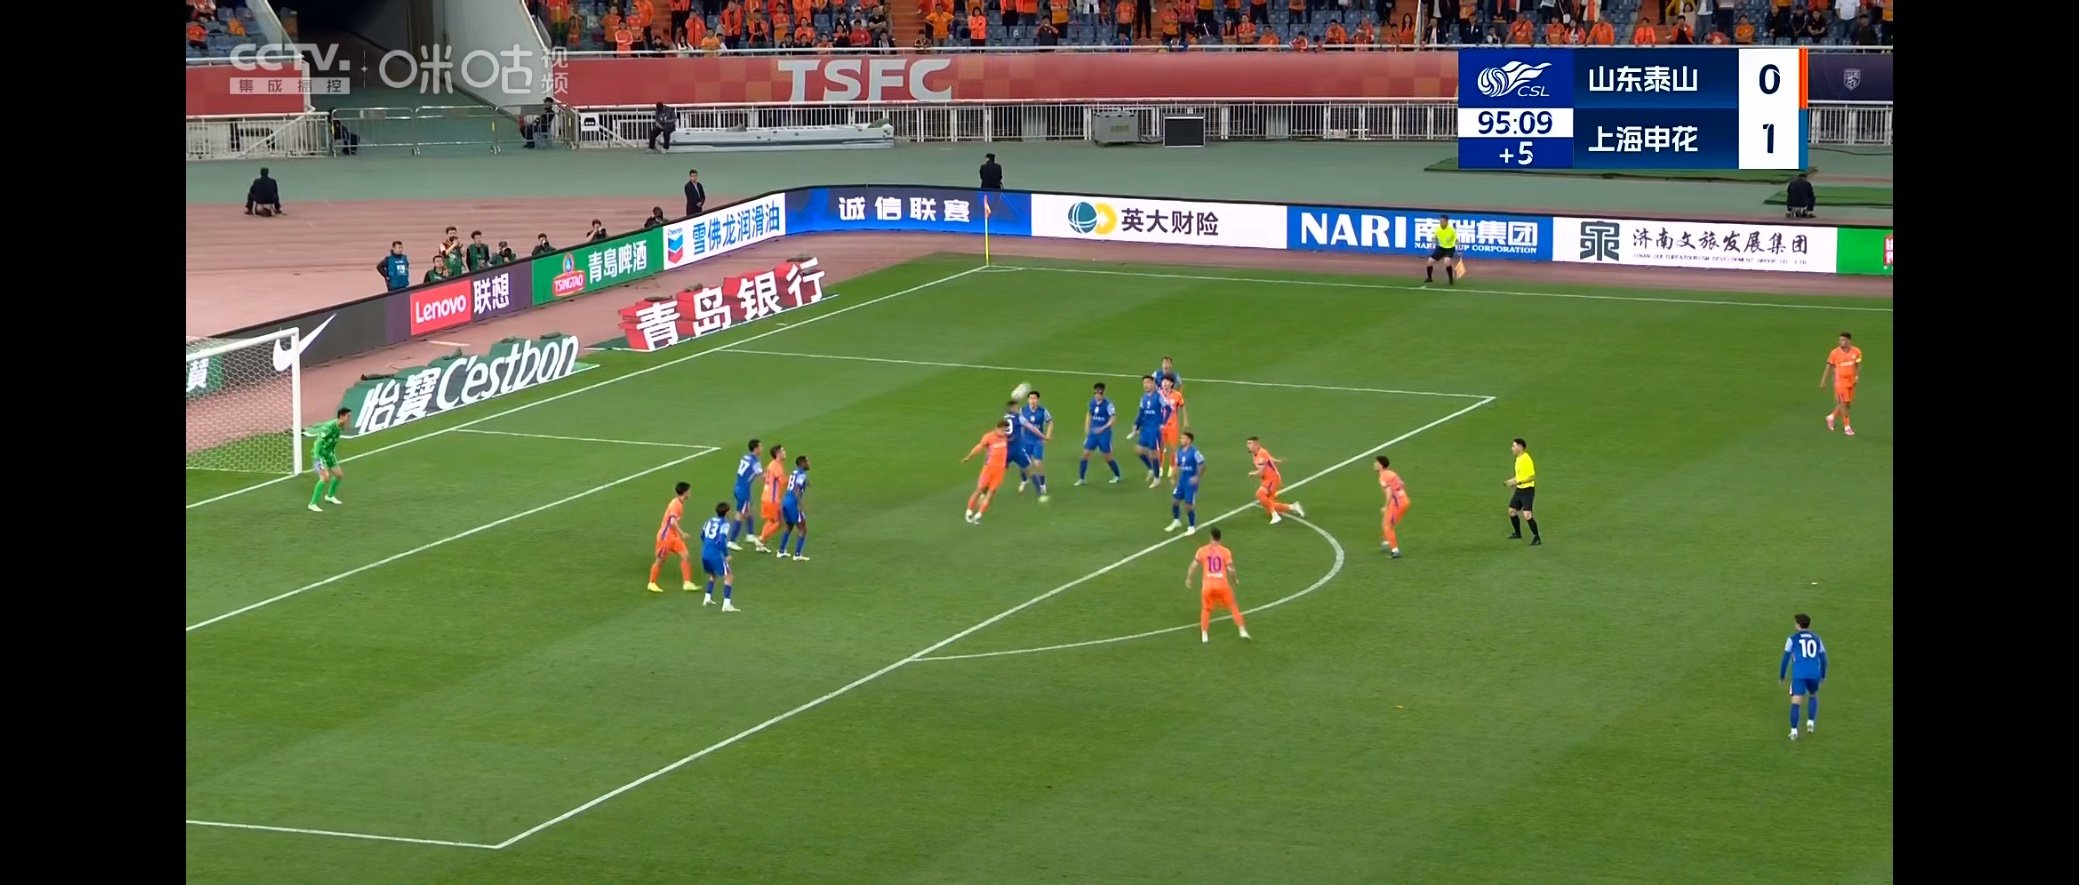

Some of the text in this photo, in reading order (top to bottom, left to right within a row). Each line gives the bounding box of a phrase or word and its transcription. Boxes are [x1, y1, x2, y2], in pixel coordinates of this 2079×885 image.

[778, 58, 952, 101] TSFC
[838, 195, 971, 222] 诚信联赛
[1121, 208, 1220, 236] 英大财险
[693, 201, 780, 255] 雪佛龙润滑油
[1301, 212, 1407, 248] NARI
[1632, 227, 1809, 255] 济南文旅发展集团
[1472, 245, 1537, 254] CORPORATION
[473, 272, 510, 313] 联想
[554, 274, 584, 292] TSINGTAO
[415, 291, 466, 325] Lenovo
[636, 257, 825, 350] 青岛银行
[1207, 555, 1222, 573] 10
[1798, 638, 1817, 658] 10
